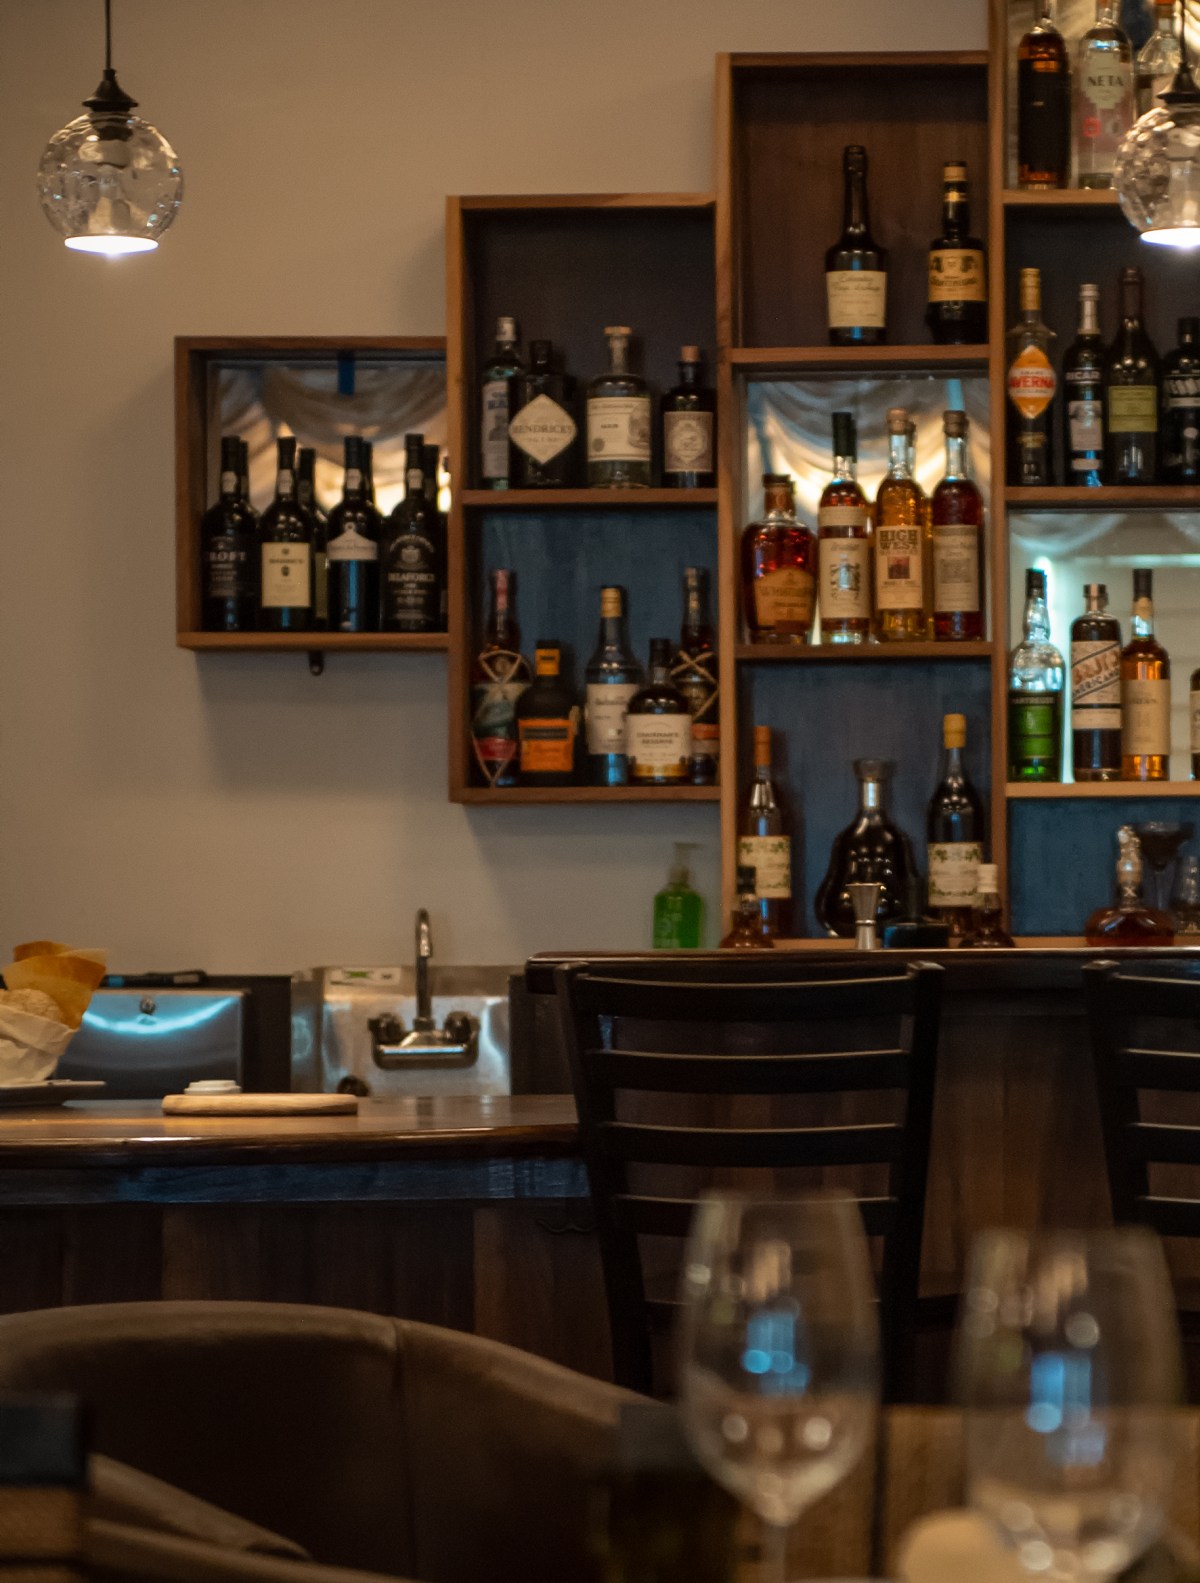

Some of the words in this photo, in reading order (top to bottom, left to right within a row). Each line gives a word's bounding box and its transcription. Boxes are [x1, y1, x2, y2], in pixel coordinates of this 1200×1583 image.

[1087, 75, 1124, 87] NETA
[879, 529, 918, 541] HIGH
[879, 541, 918, 550] WEST
